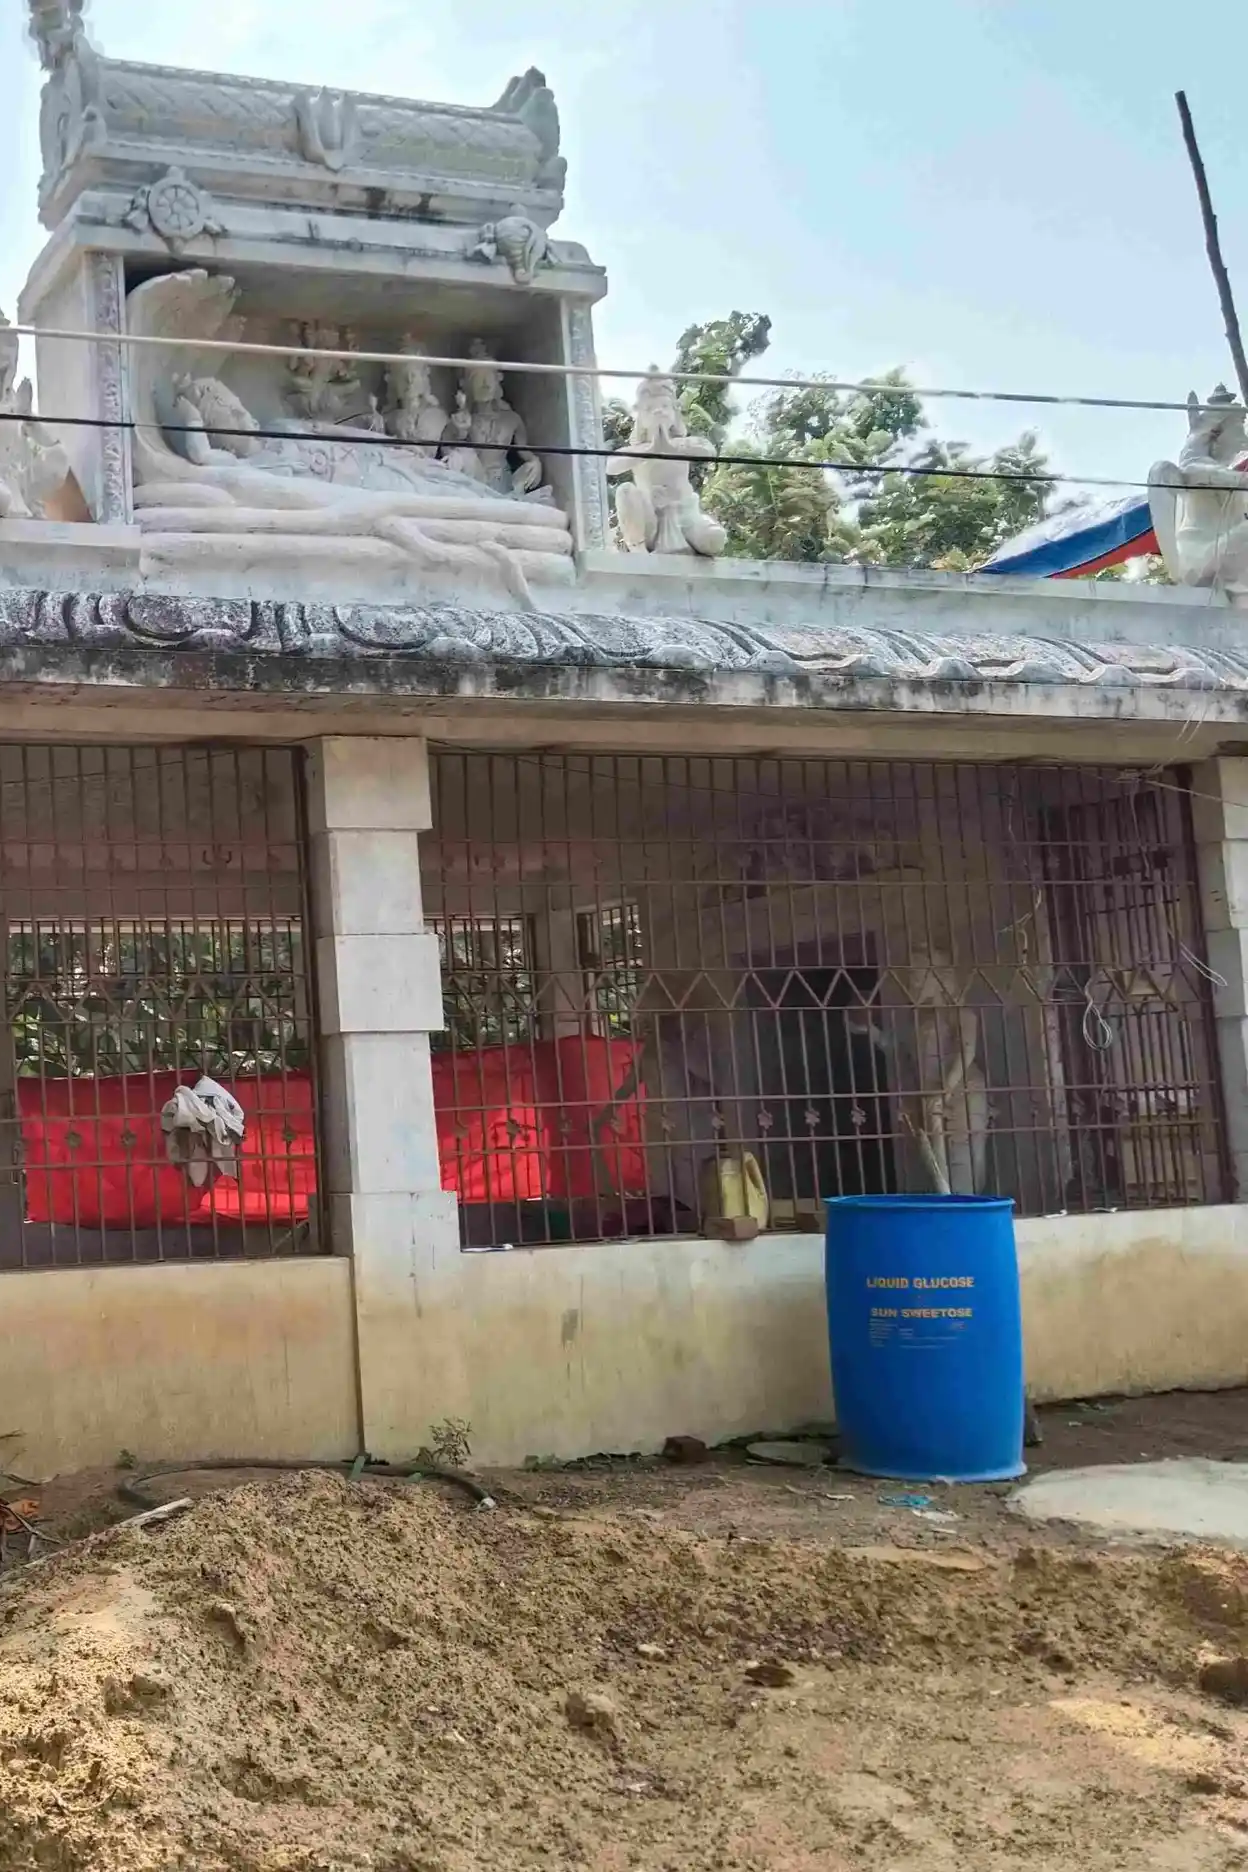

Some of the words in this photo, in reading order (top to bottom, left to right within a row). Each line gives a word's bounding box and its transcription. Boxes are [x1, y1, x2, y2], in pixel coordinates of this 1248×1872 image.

[866, 1277, 909, 1289] LIQUID
[913, 1276, 975, 1288] GLUCOSE
[871, 1307, 898, 1318] SUN
[901, 1307, 973, 1318] SWEETOSE
